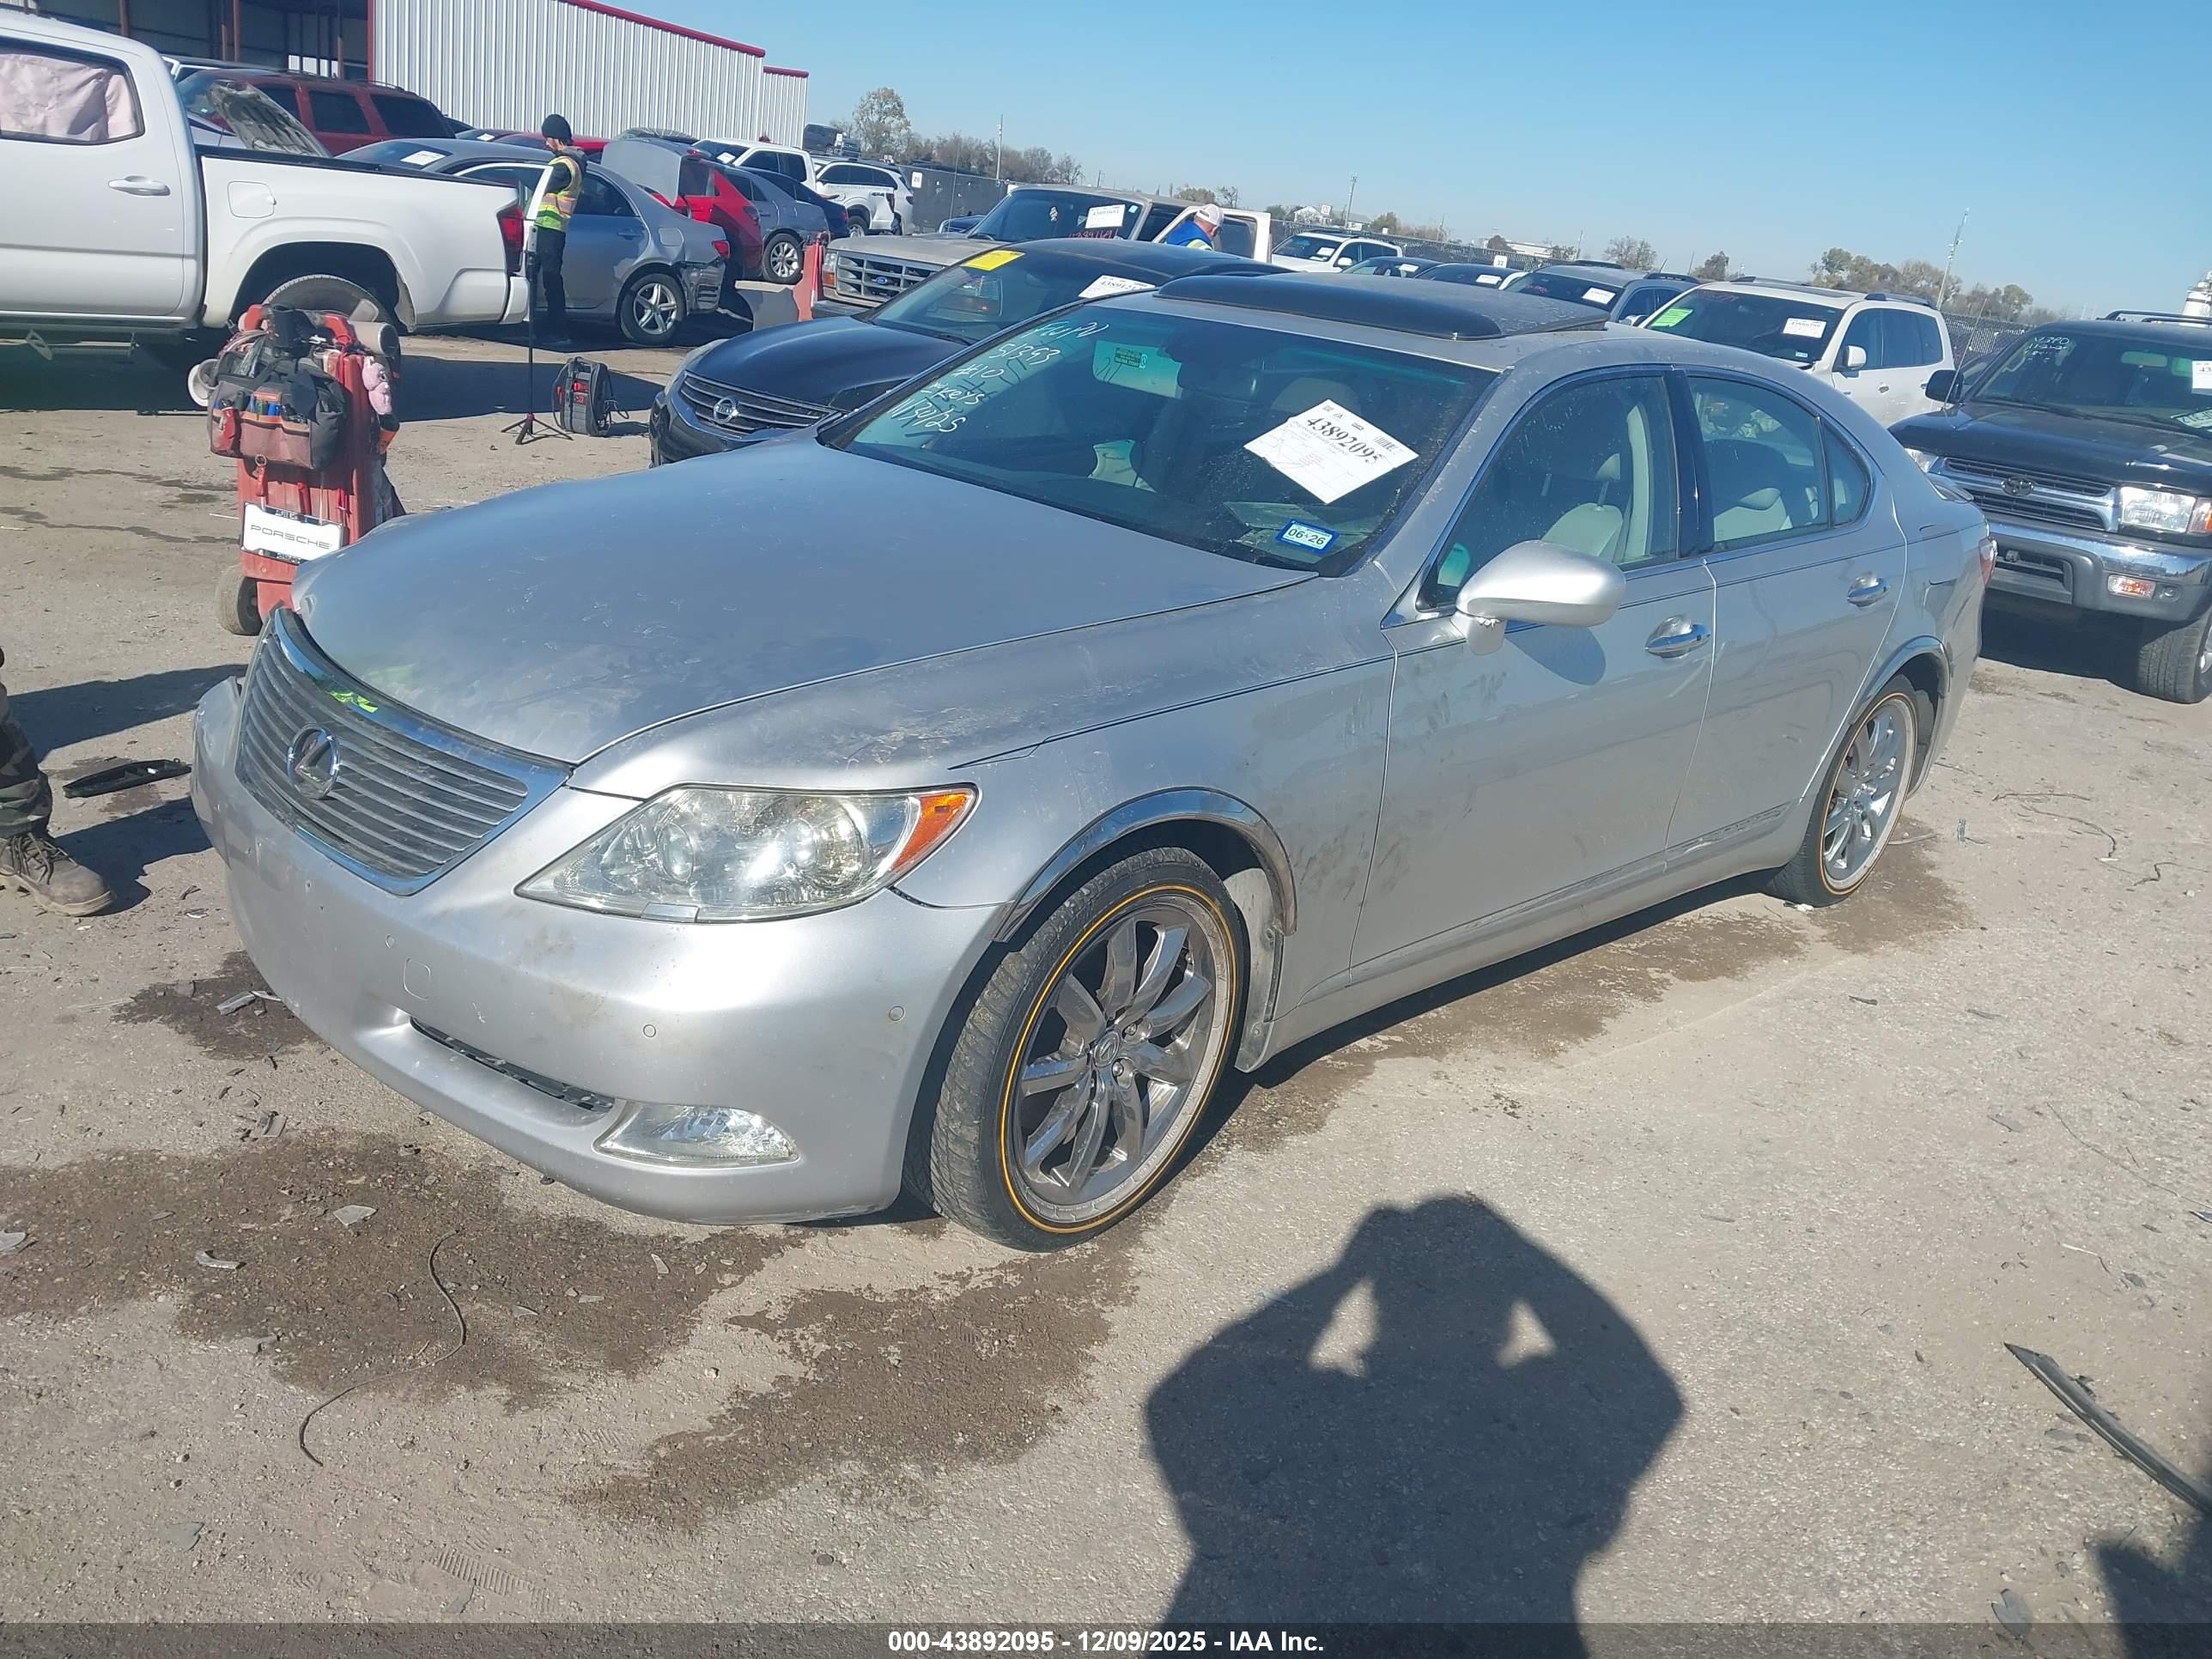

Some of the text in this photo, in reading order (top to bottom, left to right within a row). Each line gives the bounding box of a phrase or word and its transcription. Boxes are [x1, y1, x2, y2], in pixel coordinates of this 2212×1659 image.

[250, 524, 331, 550] PORSCHE
[1288, 528, 1327, 545] 06 26
